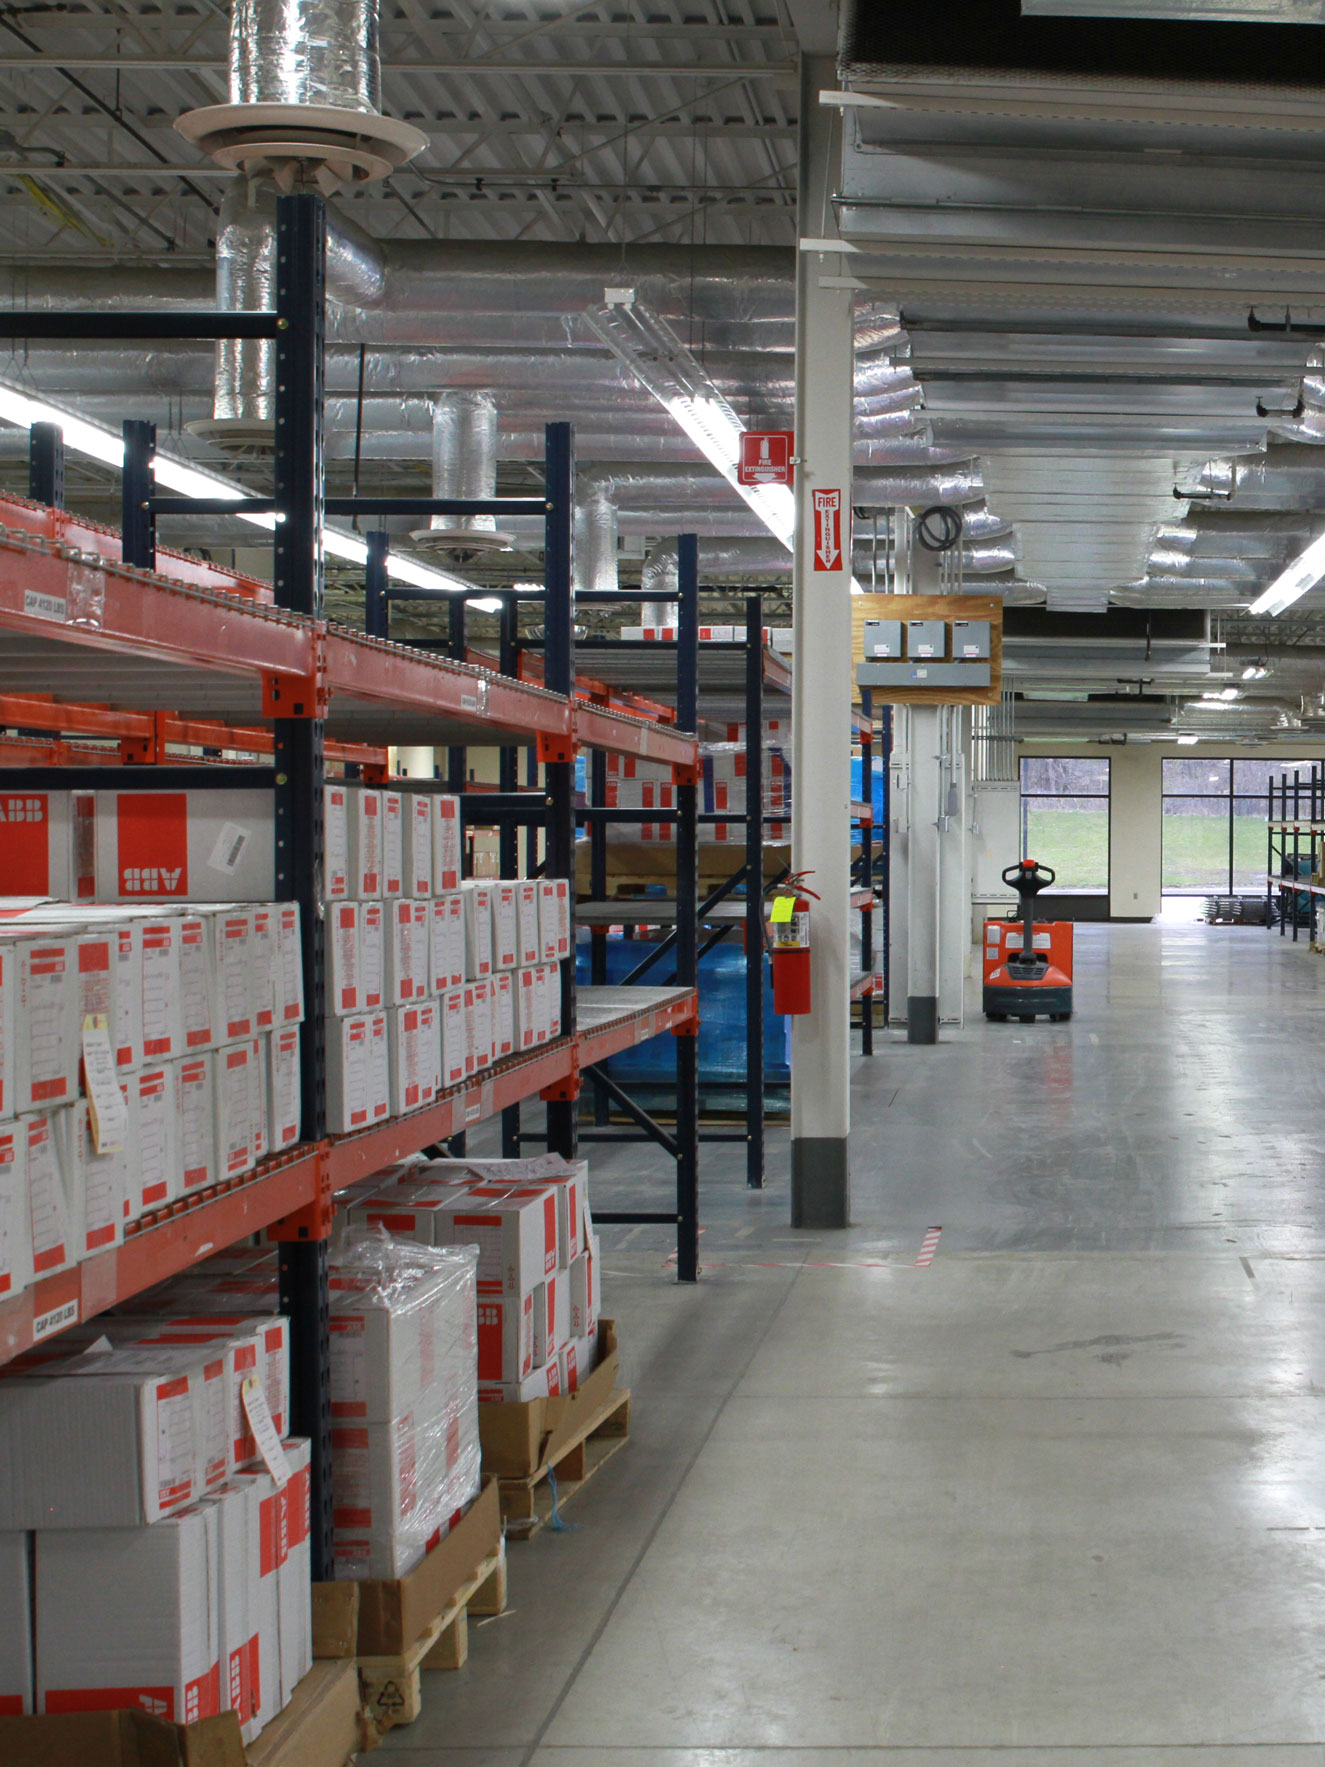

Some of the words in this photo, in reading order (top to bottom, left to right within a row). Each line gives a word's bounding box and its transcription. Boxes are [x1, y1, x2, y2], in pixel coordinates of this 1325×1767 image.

[818, 496, 836, 508] FIRE
[0, 799, 43, 822] BB
[123, 868, 182, 891] ABB
[36, 1317, 49, 1334] CAP
[64, 1304, 76, 1320] LBS
